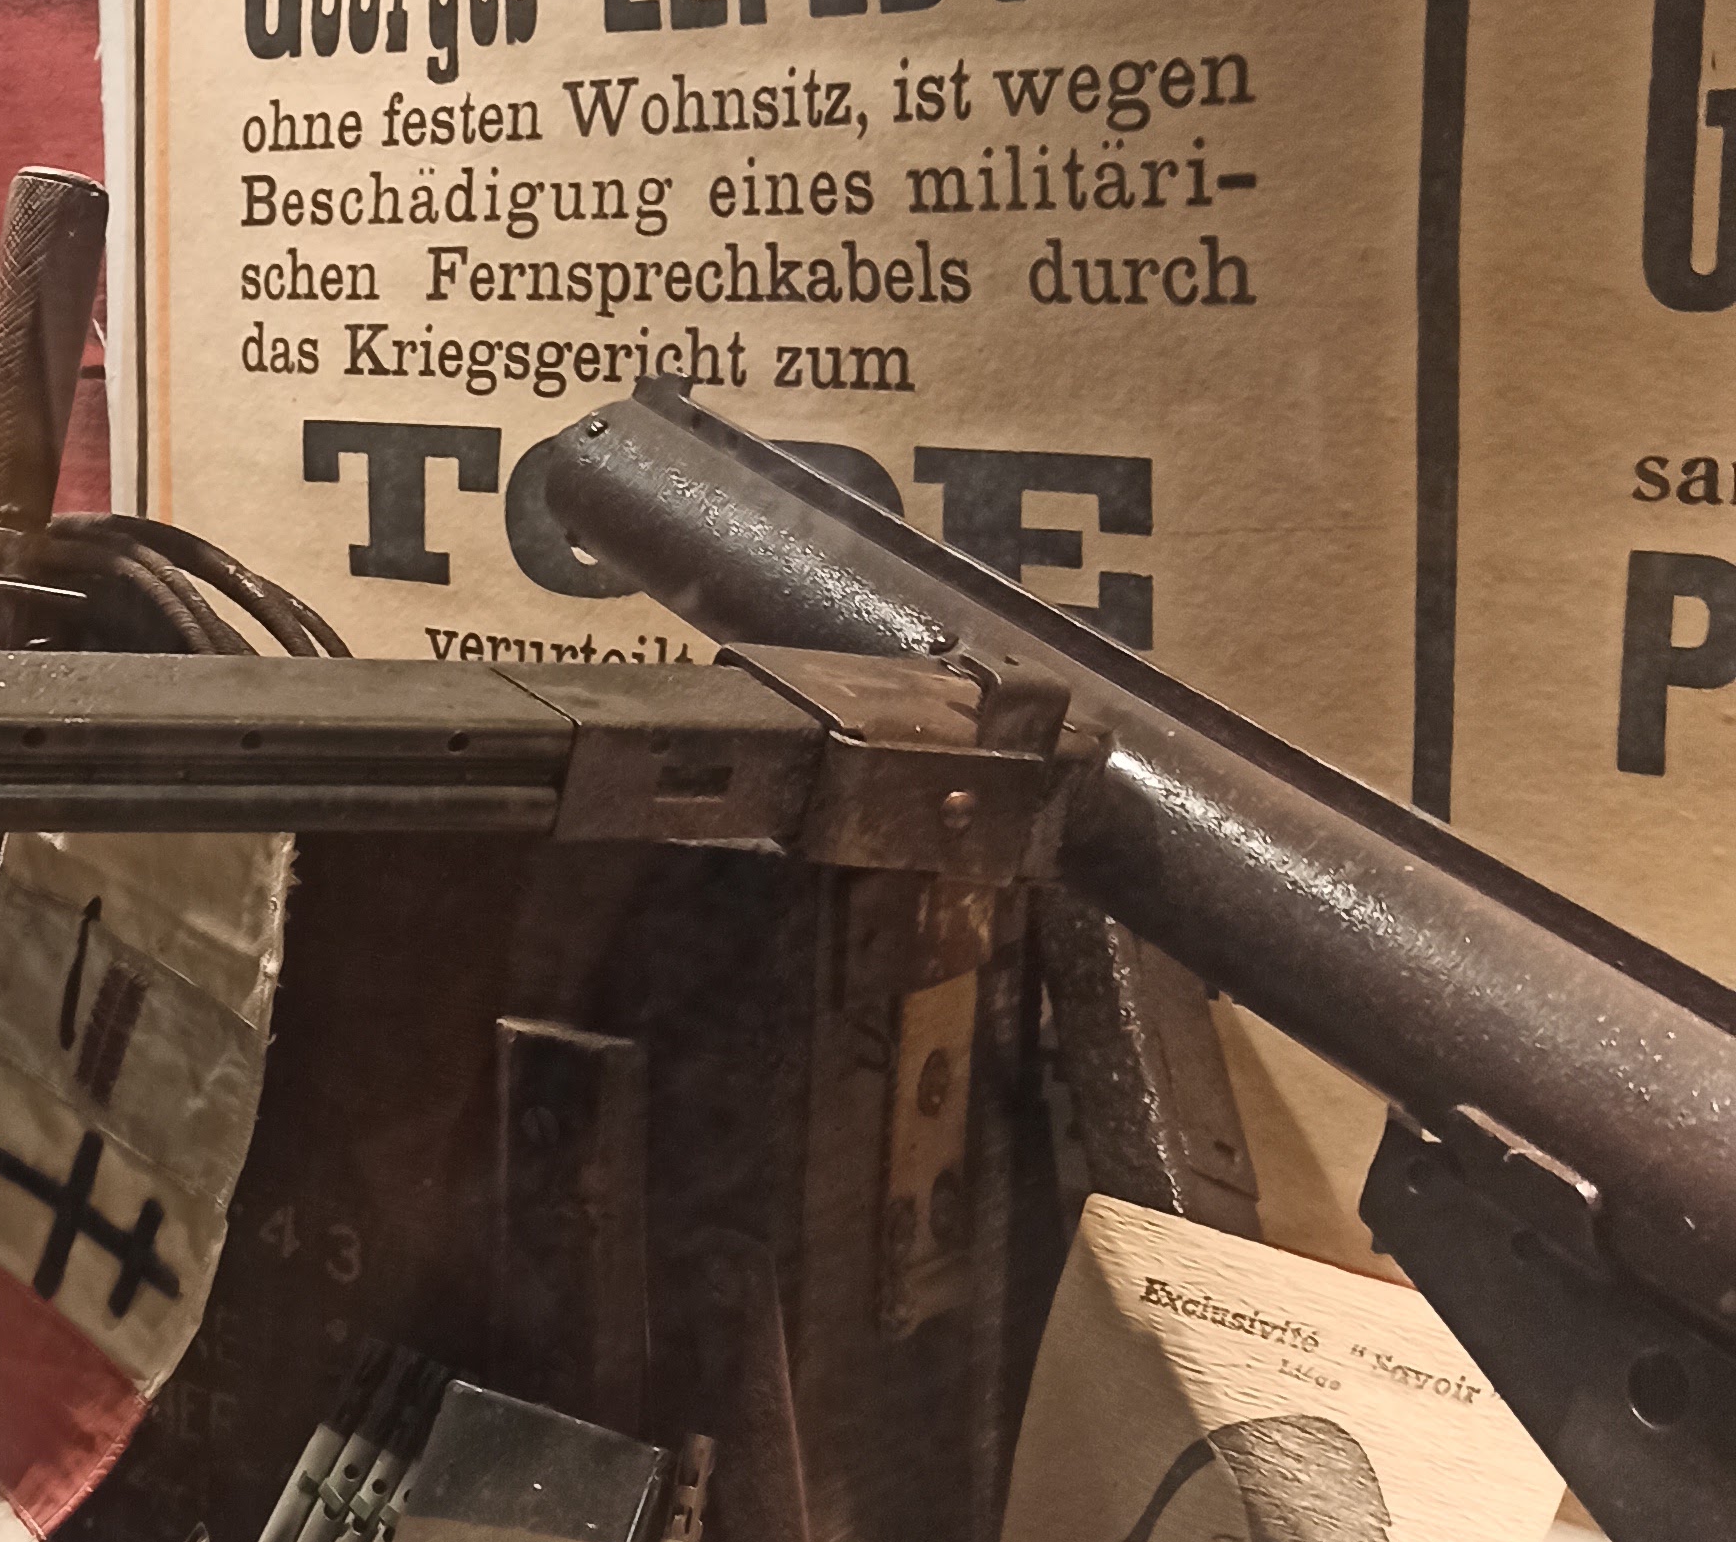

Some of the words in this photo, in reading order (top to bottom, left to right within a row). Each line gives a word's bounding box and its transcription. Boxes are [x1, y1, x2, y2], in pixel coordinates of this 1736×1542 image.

[243, 98, 362, 153] ohne
[381, 91, 543, 148] festen
[563, 65, 868, 140] Wohnsitz,
[893, 56, 972, 123] ist
[992, 52, 1257, 132] wegen
[241, 165, 673, 239] Beschädigung
[709, 156, 875, 217] eines
[905, 135, 1257, 214] militäri-
[241, 247, 380, 302] schen
[425, 238, 972, 318] Fernsprechkabels
[1029, 234, 1257, 307] durch
[241, 321, 319, 375] das
[344, 323, 747, 399] Kriegsgericht
[773, 345, 916, 392] zum
[303, 419, 1153, 651] TE
